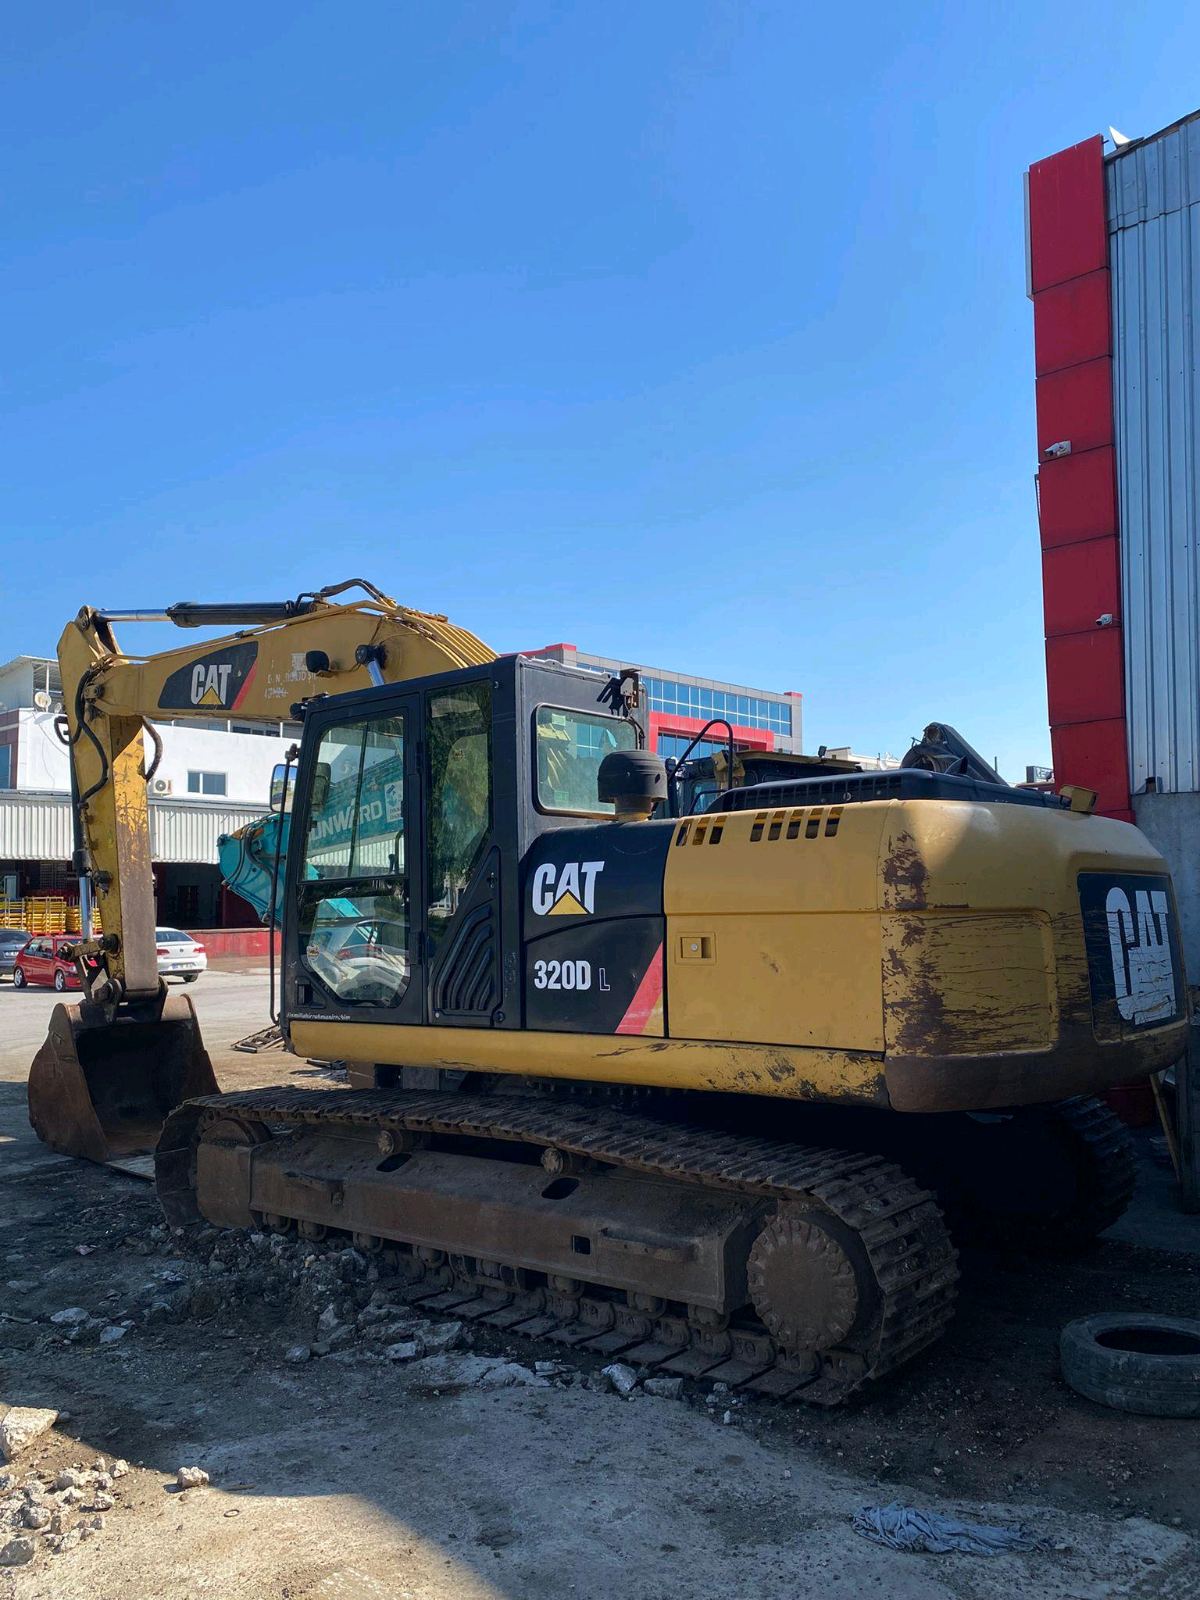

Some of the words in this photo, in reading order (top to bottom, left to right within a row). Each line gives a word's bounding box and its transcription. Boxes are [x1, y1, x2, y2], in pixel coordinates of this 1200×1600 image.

[190, 664, 232, 705] CAT
[309, 797, 383, 842] UNWARD
[532, 861, 605, 916] CAT
[534, 960, 591, 990] 320D
[599, 968, 611, 991] L
[1106, 887, 1176, 1025] CAT
